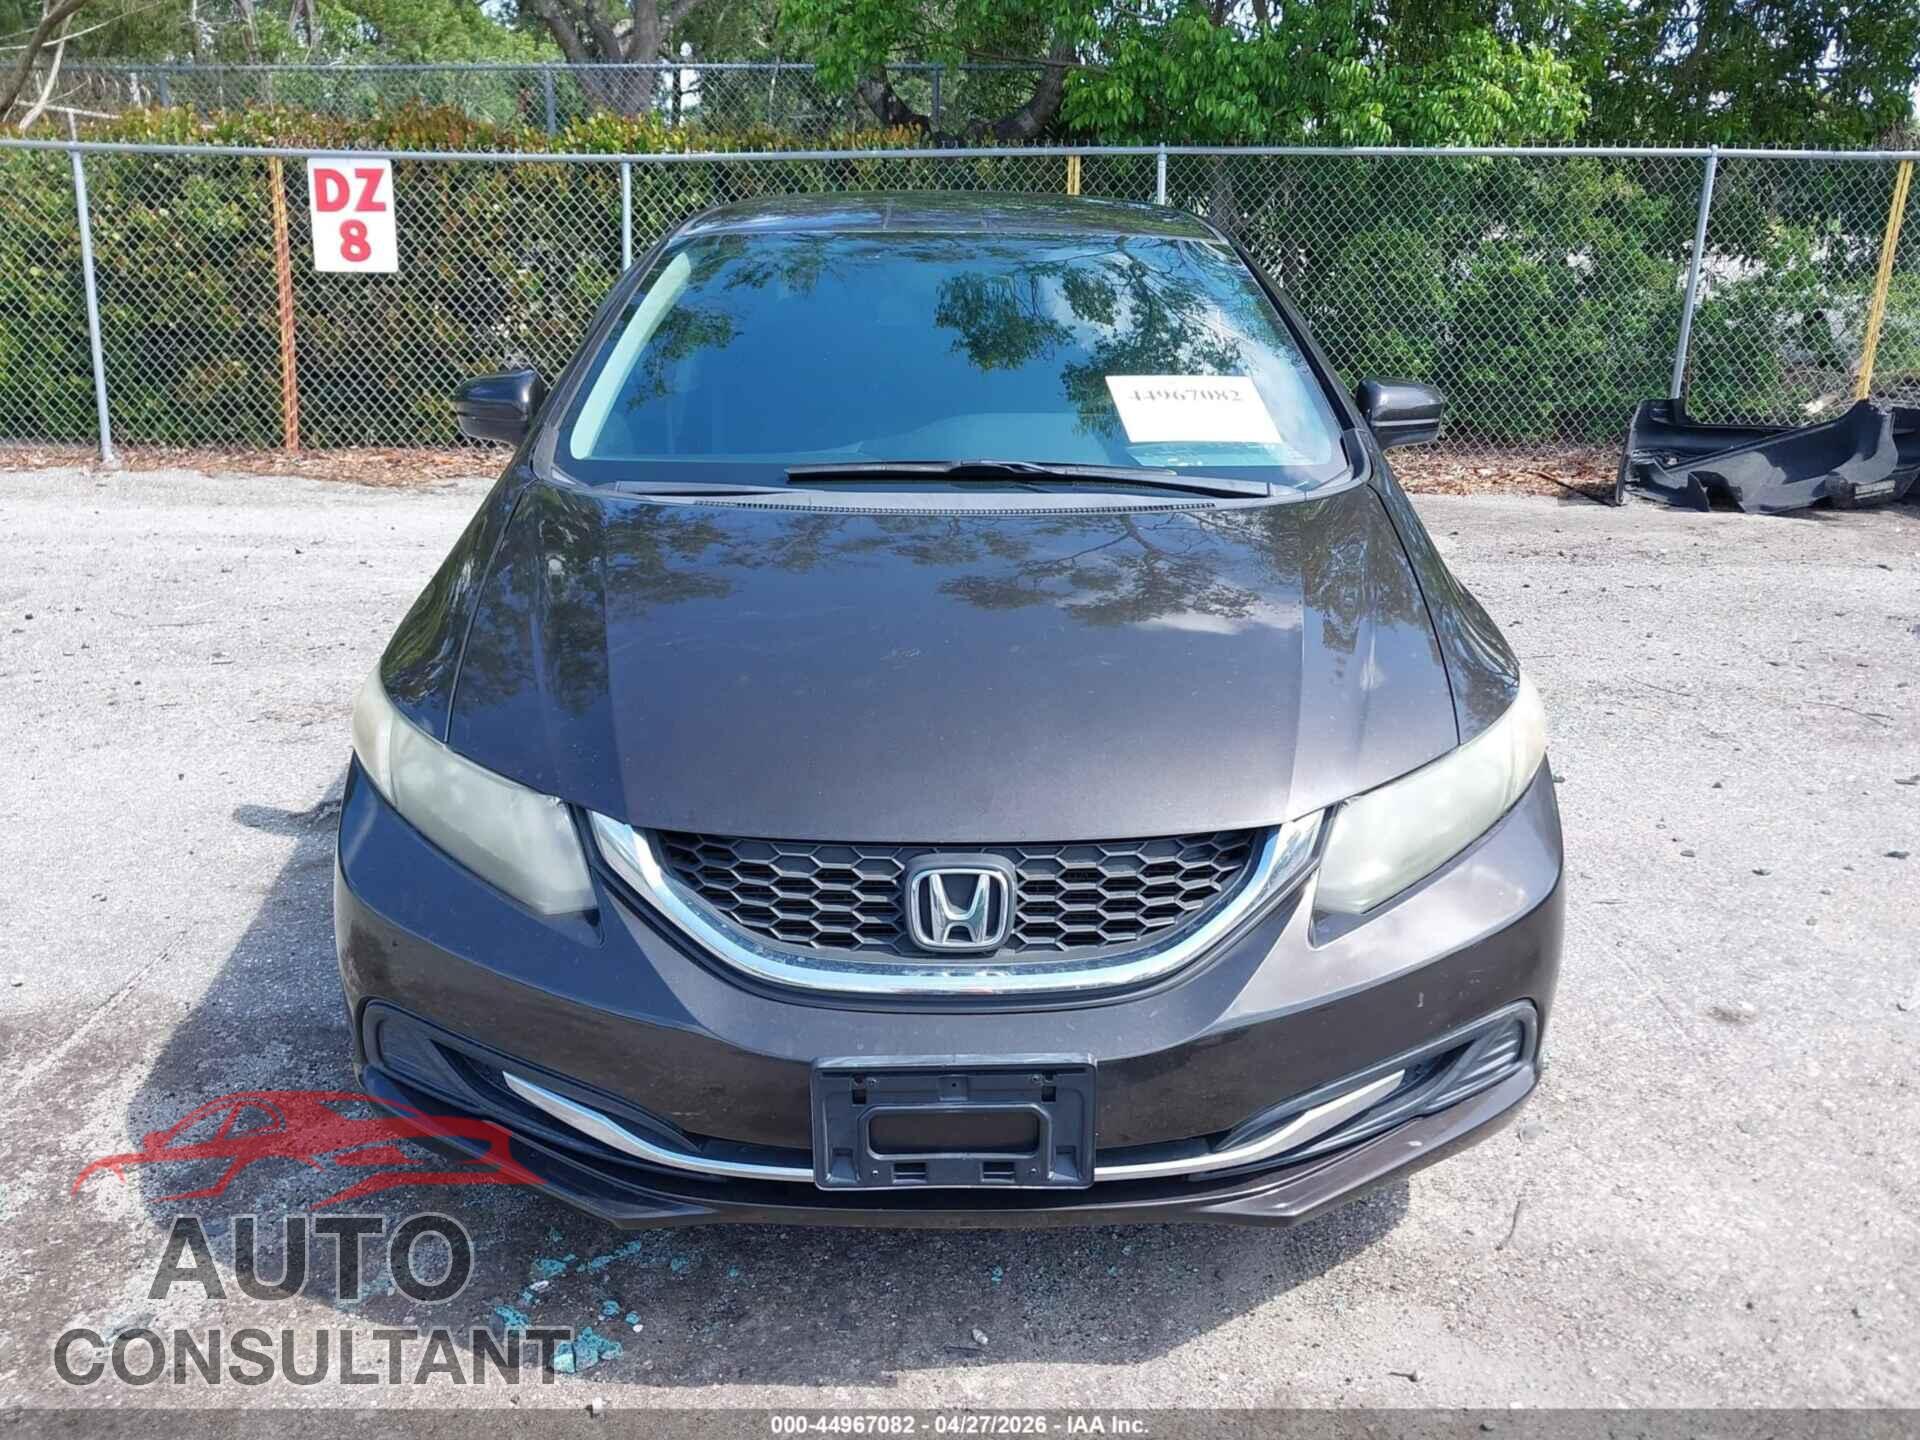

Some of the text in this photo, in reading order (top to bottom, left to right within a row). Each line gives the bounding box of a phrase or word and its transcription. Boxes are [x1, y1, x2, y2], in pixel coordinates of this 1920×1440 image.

[313, 168, 387, 212] DZ
[339, 219, 371, 262] 8
[1129, 389, 1244, 402] 44967082
